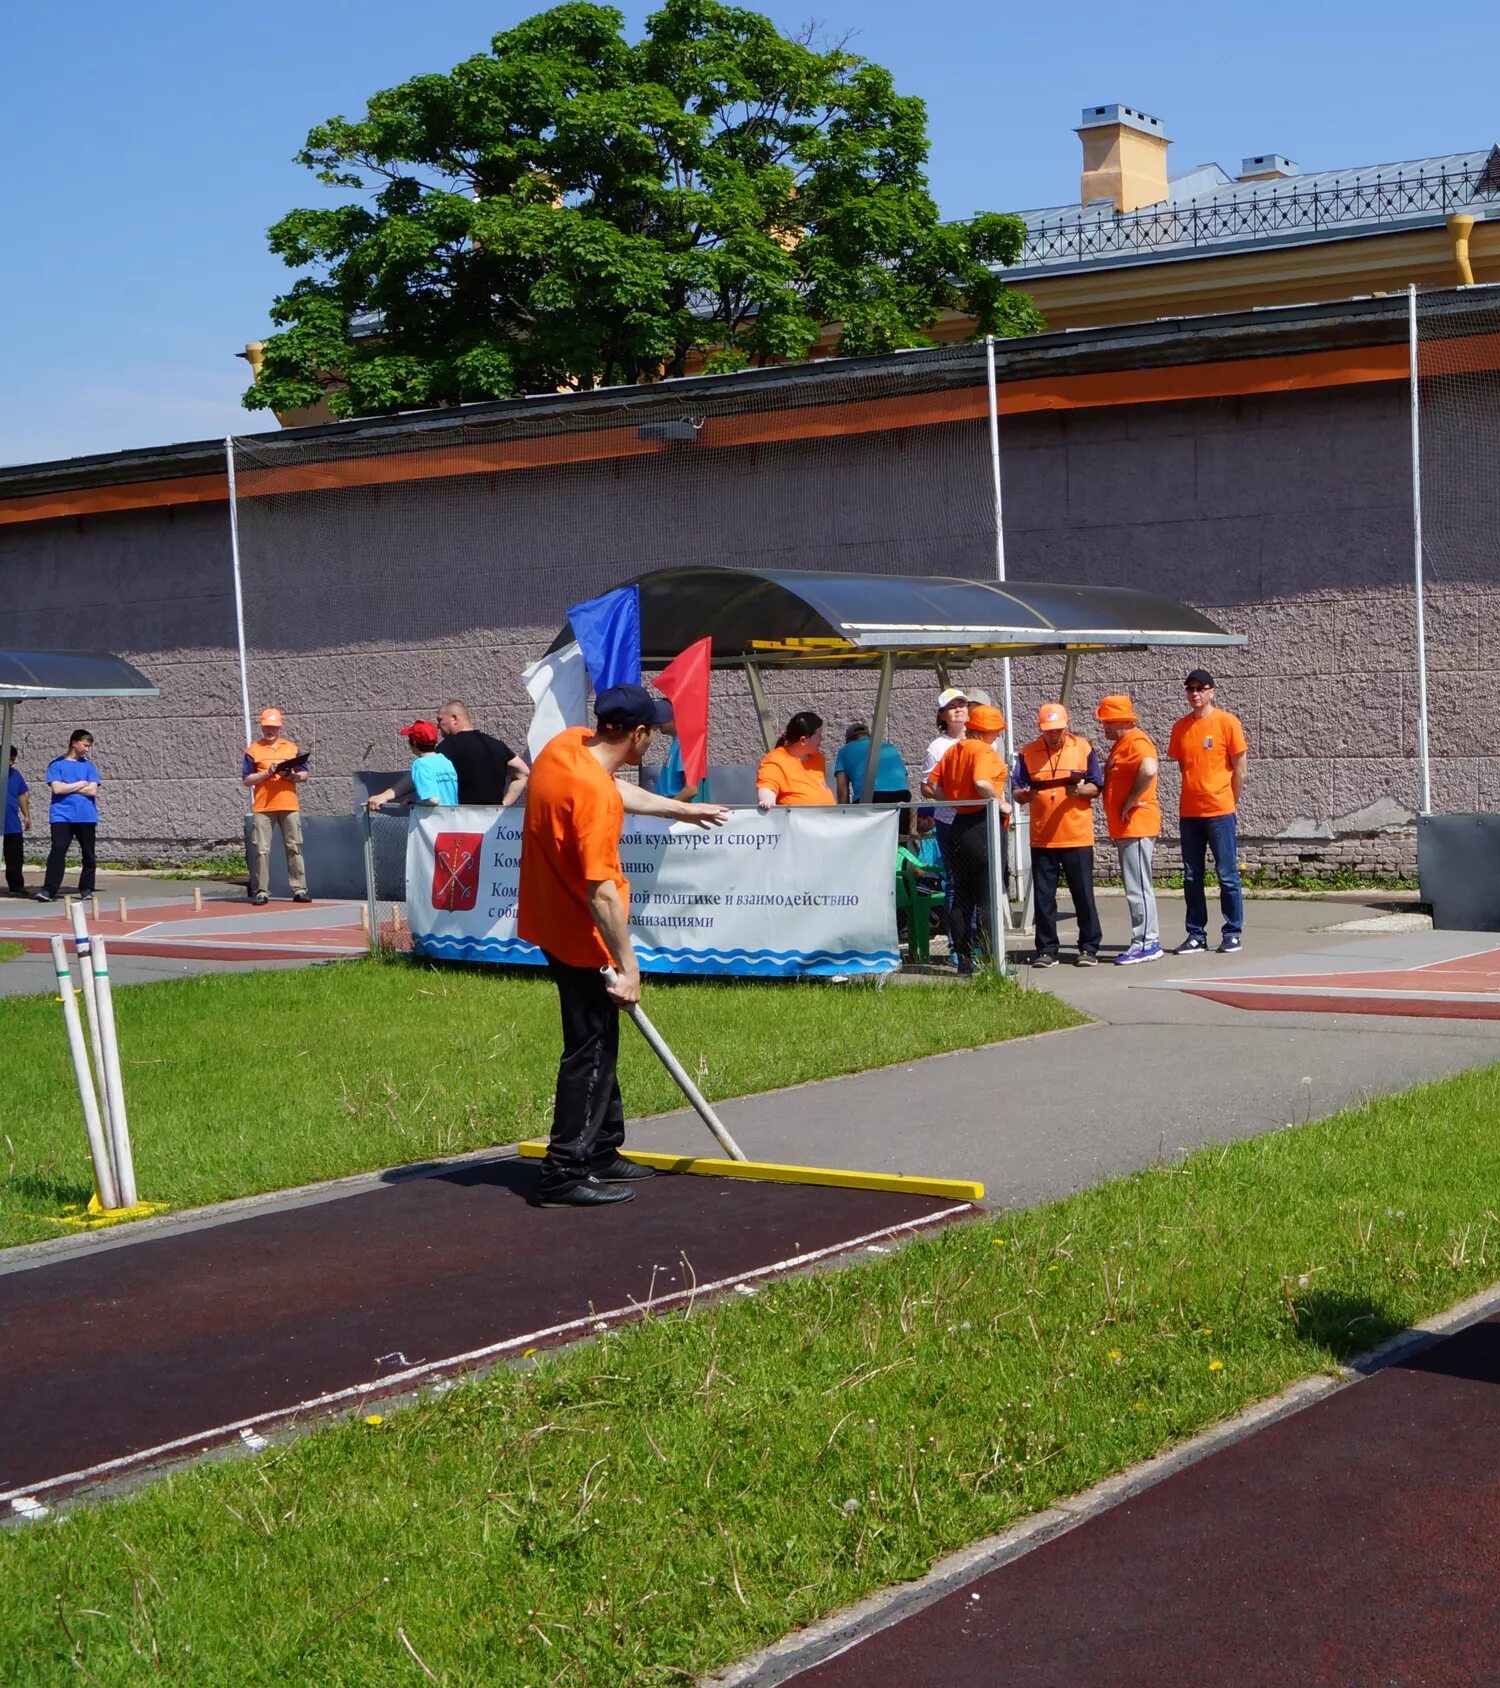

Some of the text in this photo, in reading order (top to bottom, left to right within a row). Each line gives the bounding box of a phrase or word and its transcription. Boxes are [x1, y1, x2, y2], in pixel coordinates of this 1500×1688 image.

[646, 833, 710, 850] культуре
[714, 834, 723, 845] и
[728, 834, 781, 850] спорту
[654, 893, 721, 905] политике
[725, 894, 733, 905] и
[736, 891, 859, 907] взаимодействию
[488, 907, 495, 918] с
